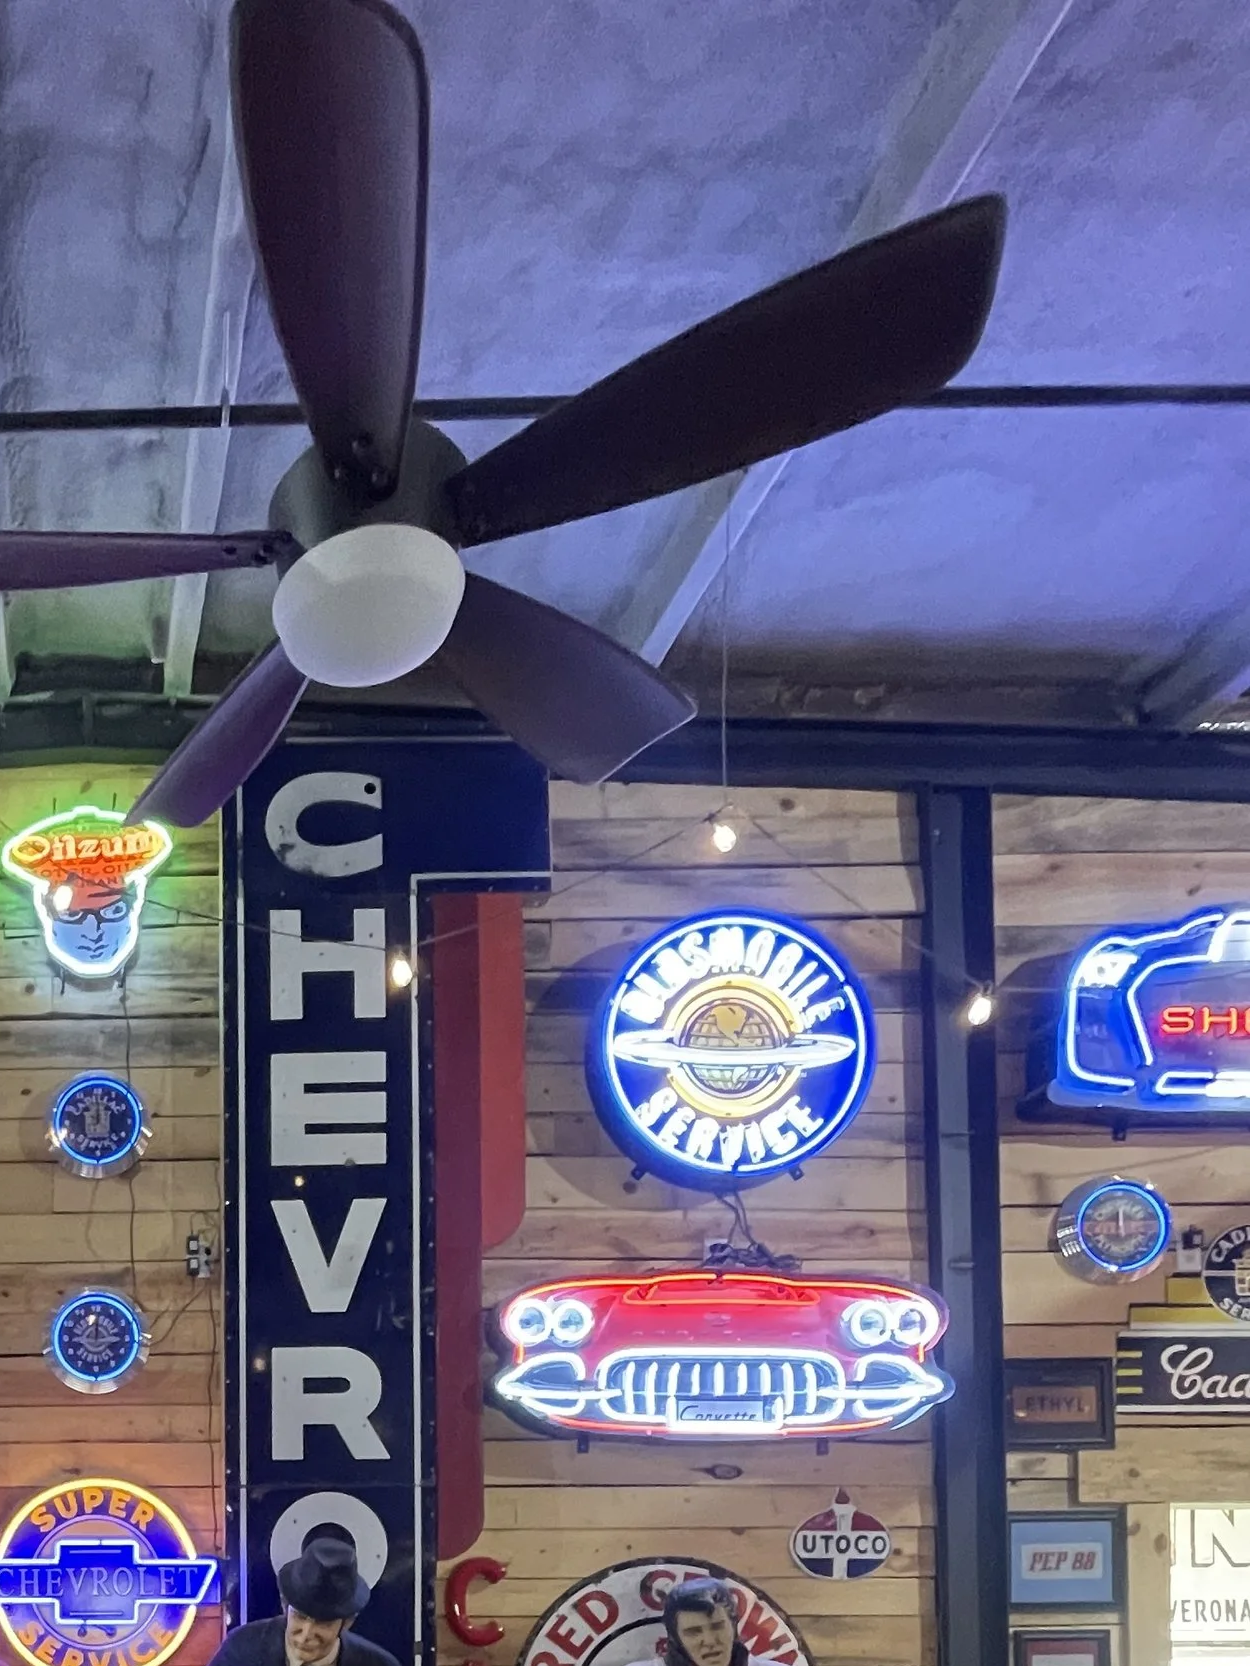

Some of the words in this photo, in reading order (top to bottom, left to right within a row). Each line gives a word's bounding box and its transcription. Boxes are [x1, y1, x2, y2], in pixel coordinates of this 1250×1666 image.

[11, 830, 164, 862] Oilzum
[620, 926, 846, 1031] OLDSMOBILE
[1161, 1006, 1250, 1035] SH
[634, 1087, 825, 1164] SERVICE
[265, 771, 390, 1592] CHEVRO
[1025, 1397, 1087, 1413] ETHYL
[30, 1488, 155, 1532] SUPER
[802, 1534, 886, 1554] UTOCO
[1029, 1552, 1068, 1572] PEP
